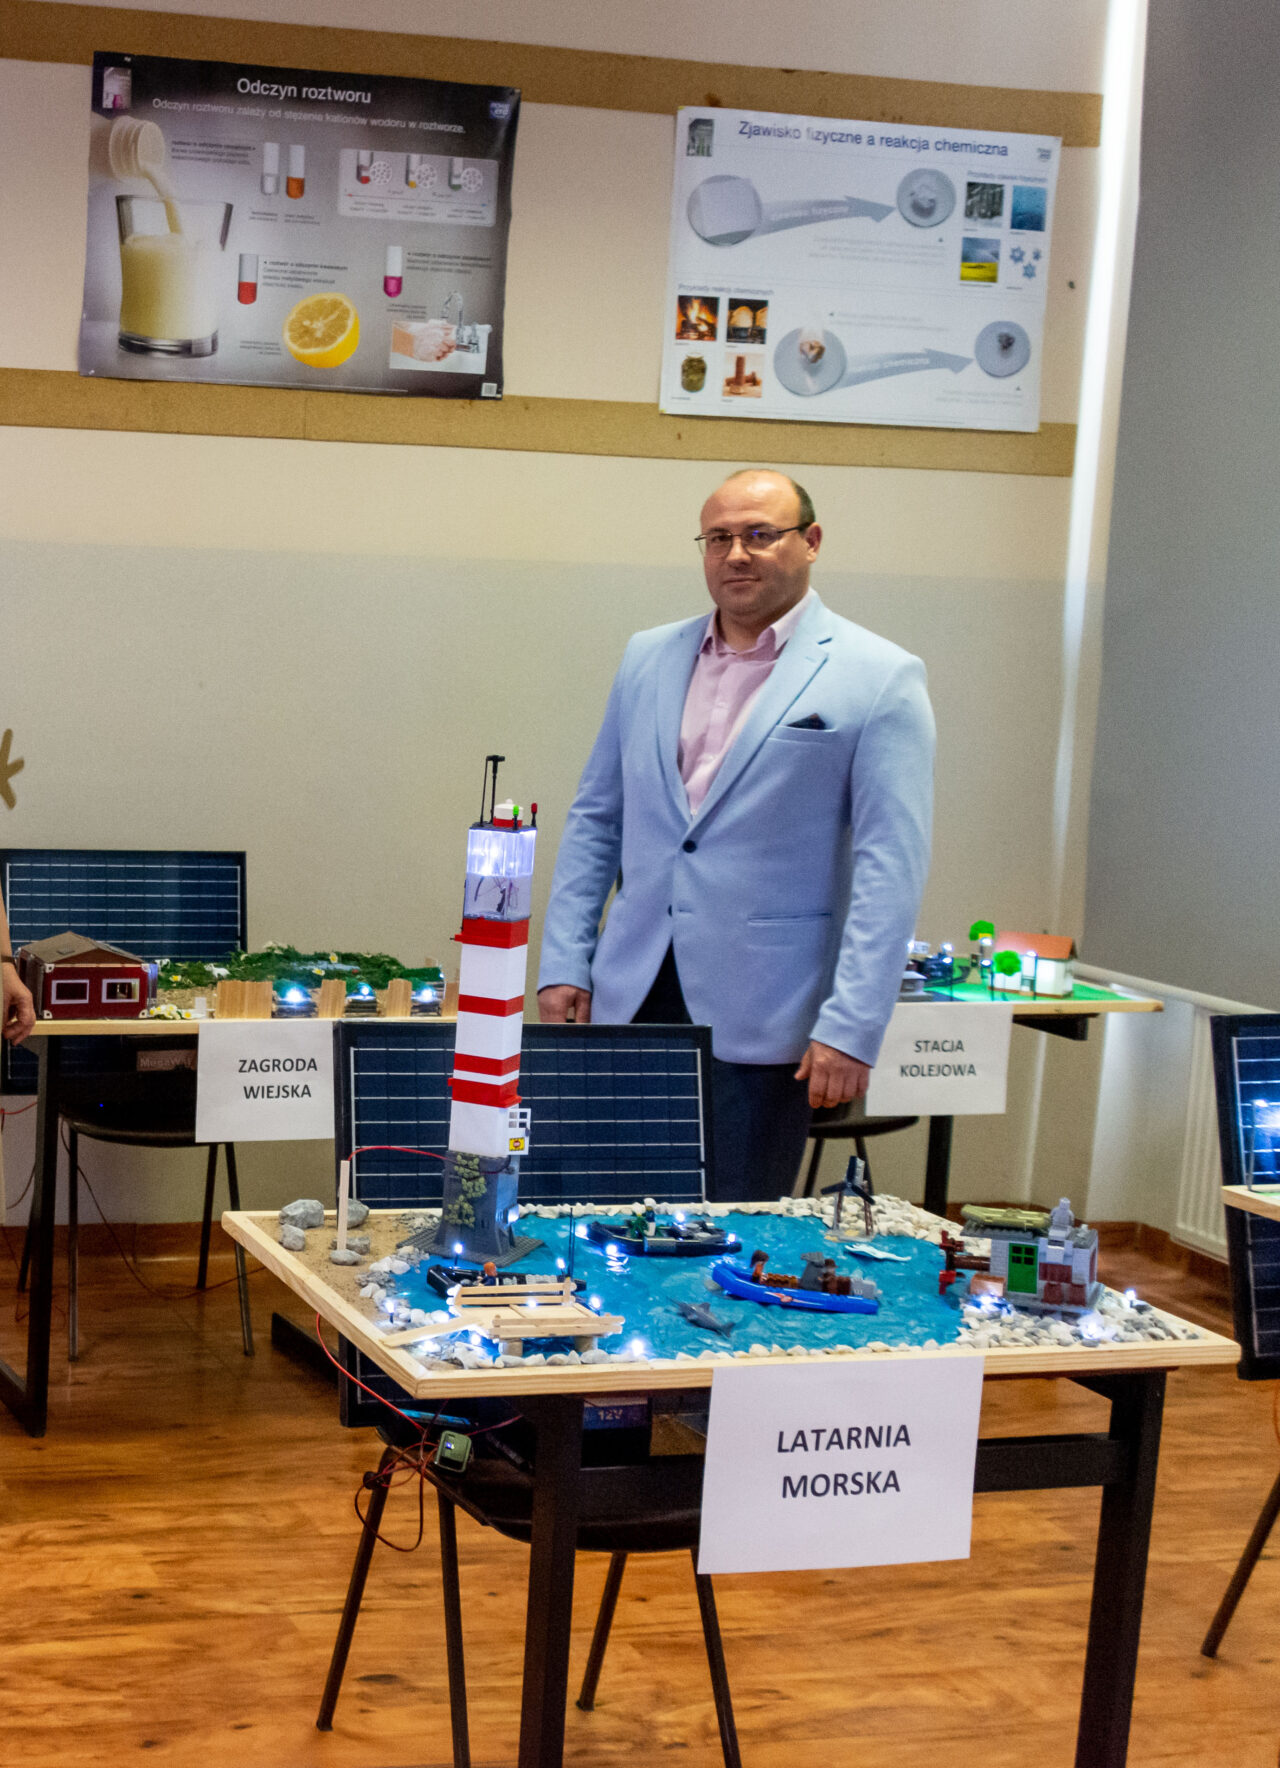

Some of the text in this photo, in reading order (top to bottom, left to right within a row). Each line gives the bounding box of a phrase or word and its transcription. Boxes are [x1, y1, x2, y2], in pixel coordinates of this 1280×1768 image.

[237, 78, 371, 104] Odczyn roztworu
[152, 98, 190, 112] Odczyn
[192, 103, 234, 114] roztworu
[268, 109, 281, 118] od
[408, 121, 416, 129] w
[738, 120, 801, 139] Zjawisko
[866, 135, 875, 146] a
[880, 136, 929, 153] reakcja
[934, 138, 1008, 156] chemiczna
[914, 1039, 965, 1053] STACJA
[238, 1058, 318, 1073] ZAGRODA
[900, 1064, 977, 1077] KOLEJOWA
[243, 1084, 312, 1099] WIEJSKA
[598, 1409, 623, 1421] 12V
[777, 1424, 911, 1453] LATARNIA
[782, 1470, 901, 1499] MORSKA
